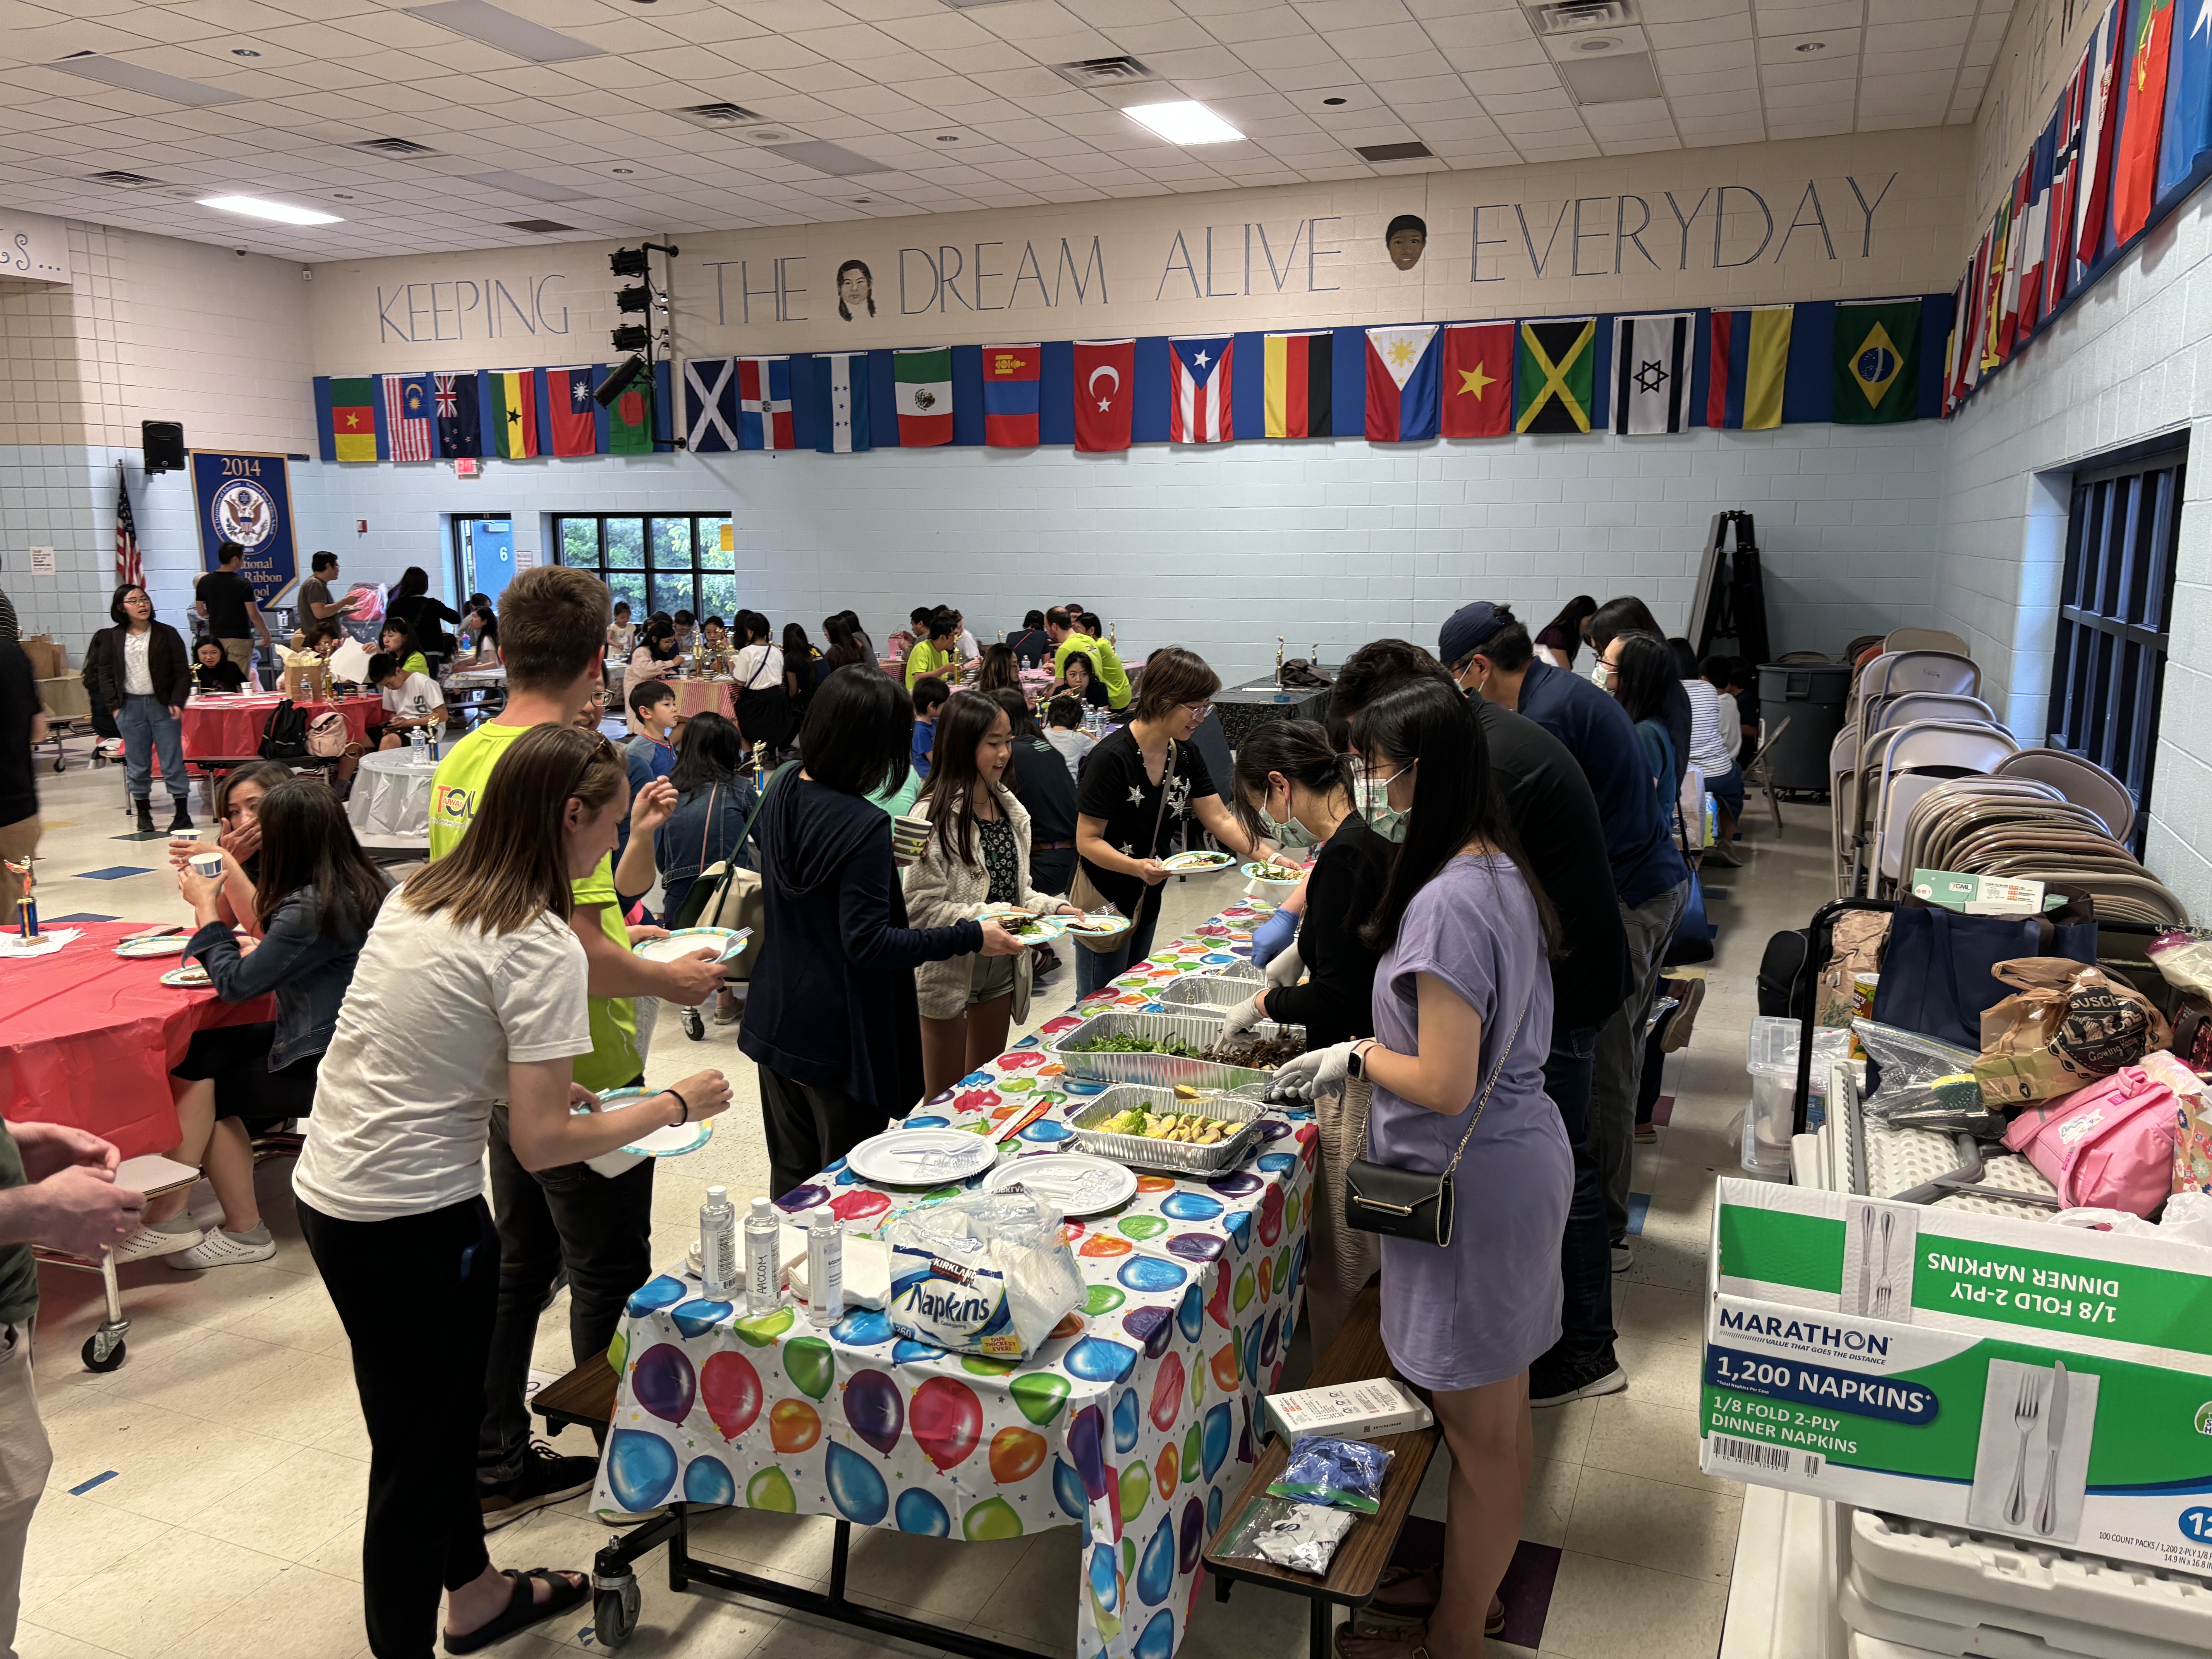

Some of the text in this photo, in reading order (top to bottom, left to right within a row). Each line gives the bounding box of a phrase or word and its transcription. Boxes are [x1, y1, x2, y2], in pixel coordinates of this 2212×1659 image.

[377, 172, 1898, 343] KEEPING THE DREAM ALIVE EVERYDAY
[220, 457, 261, 477] 2014
[241, 557, 273, 569] tional
[500, 546, 508, 561] 6
[244, 571, 282, 583] Ribbon
[254, 584, 270, 596] ool
[2088, 1046, 2123, 1061] Growing
[756, 1255, 768, 1294] AACCOM
[933, 1258, 977, 1281] KIRKLAND
[1928, 1253, 2119, 1298] DINNER NAPKINS
[904, 1282, 990, 1323] Napkins
[1950, 1282, 2116, 1323] 1/8 FOLD 2-PLY
[1720, 1308, 1888, 1356] MARATHON
[1765, 1338, 1886, 1365] VALUE THAT GOES THE DISTANCE
[1717, 1357, 1790, 1387] 1,200
[1714, 1396, 1841, 1432] 1/8 FOLD 2-PLY
[1712, 1412, 1857, 1454] DINNER NAPKINS
[2099, 1532, 2111, 1541] 100
[2111, 1534, 2135, 1545] COUNT
[2135, 1539, 2155, 1549] PACKS
[2161, 1544, 2178, 1554] 1,200
[2179, 1547, 2196, 1557] 2-PLY
[2198, 1550, 2208, 1559] 1/8
[2164, 1554, 2177, 1563] 14.9
[2179, 1556, 2186, 1565] IN
[2192, 1559, 2206, 1568] 16.8
